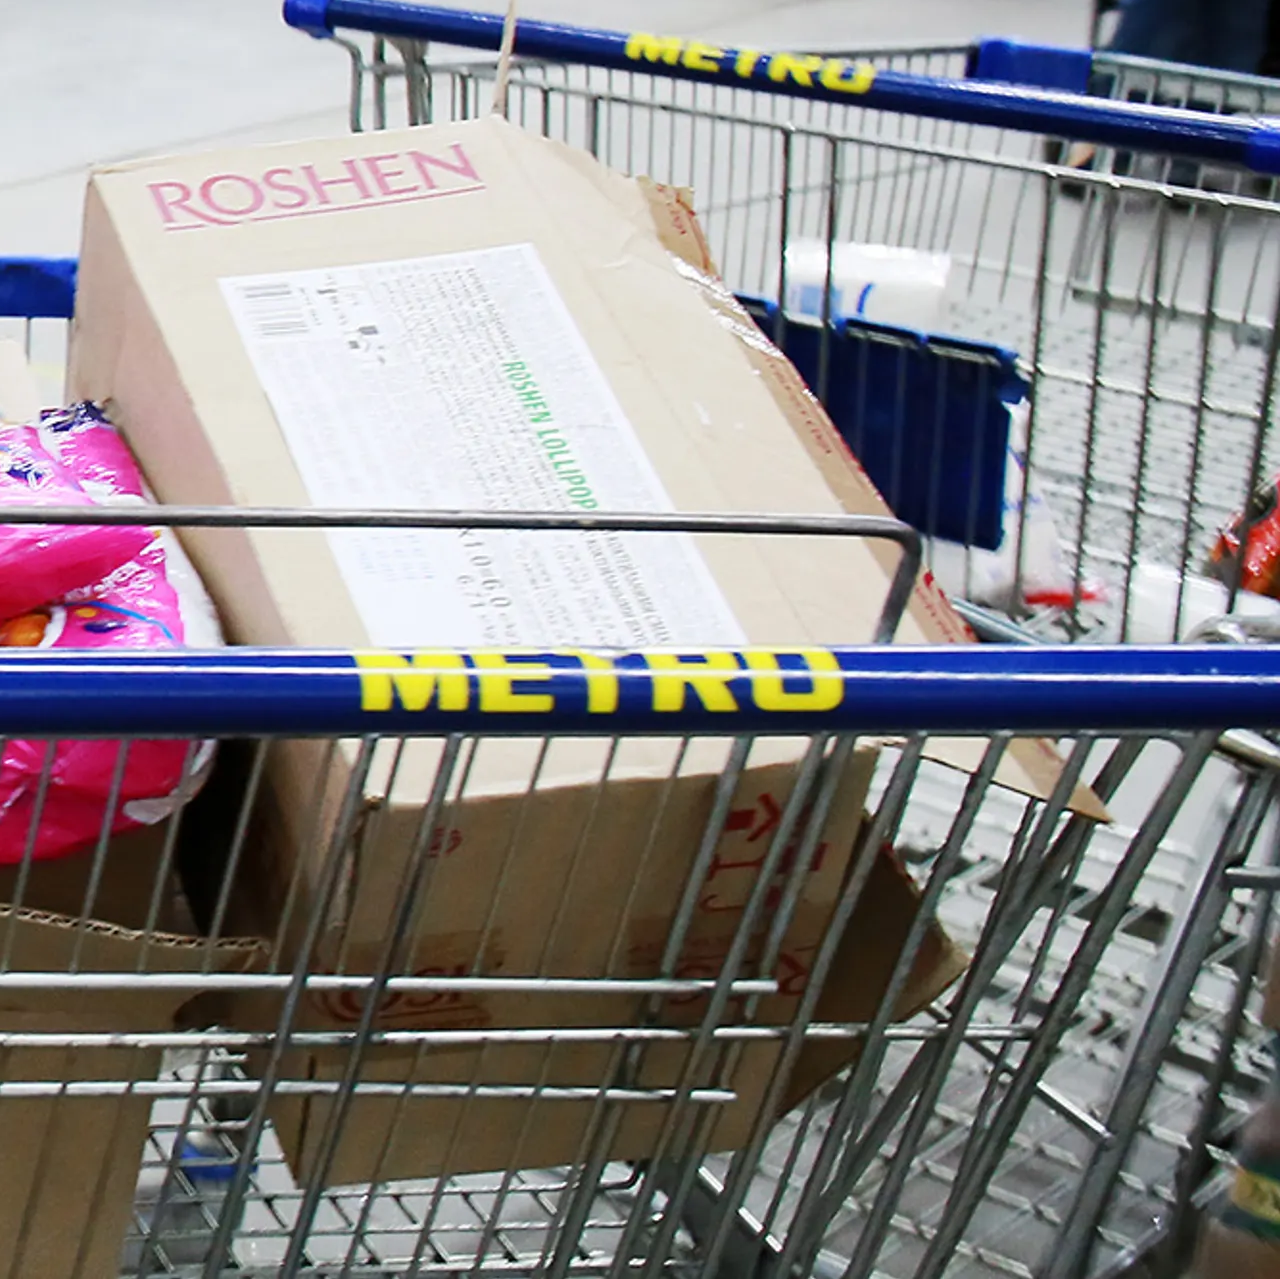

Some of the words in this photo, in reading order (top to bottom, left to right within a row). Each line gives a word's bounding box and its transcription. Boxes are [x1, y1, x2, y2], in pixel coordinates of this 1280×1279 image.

[624, 33, 876, 94] METRO
[145, 143, 481, 225] ROSHEN
[502, 361, 553, 424] ROSHEN
[353, 646, 844, 713] METRO
